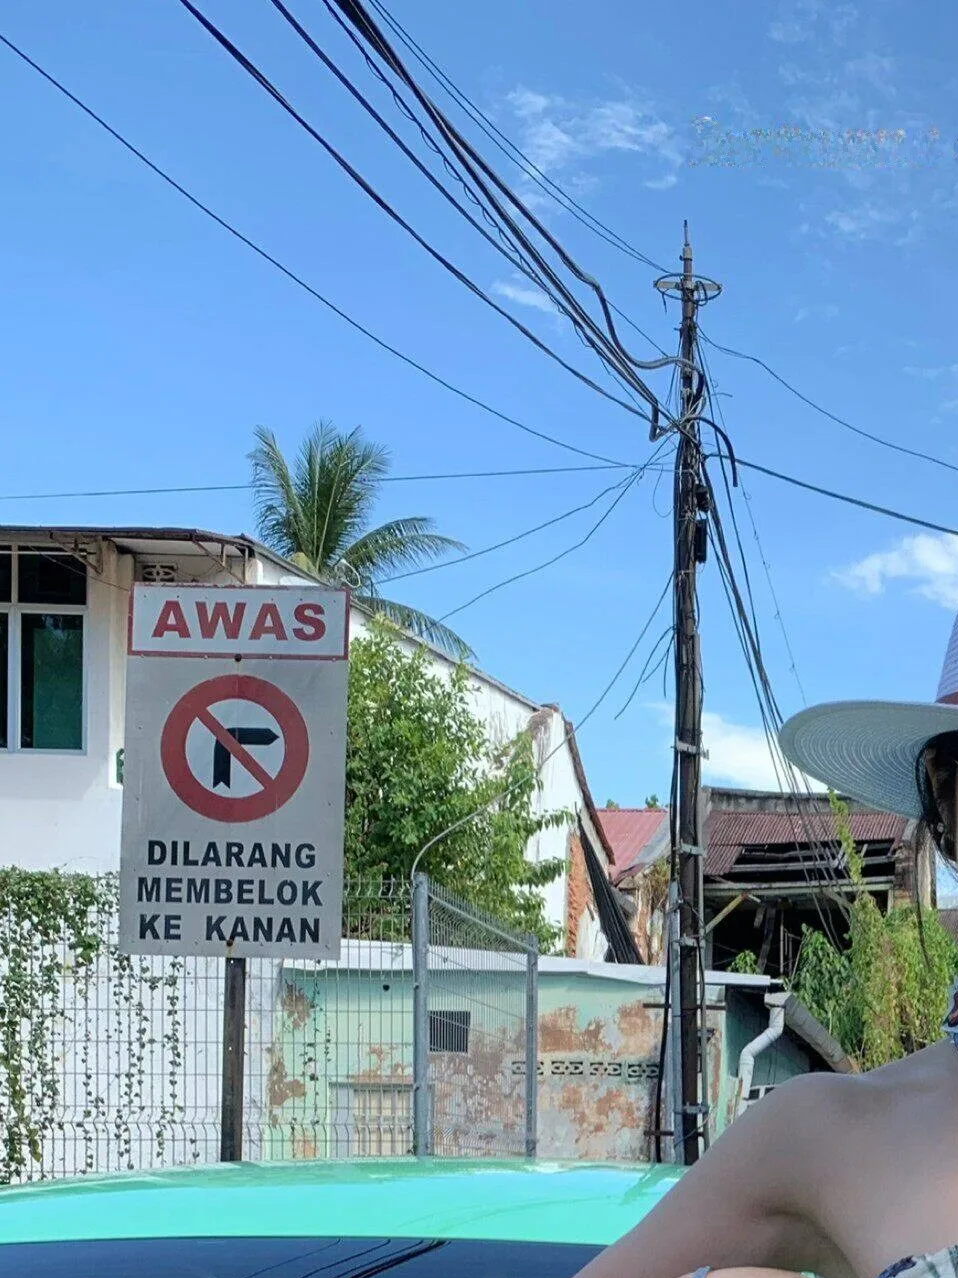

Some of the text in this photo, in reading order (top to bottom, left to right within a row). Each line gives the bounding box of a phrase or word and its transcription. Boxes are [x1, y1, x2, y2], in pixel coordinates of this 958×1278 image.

[151, 600, 326, 641] AWAS
[147, 839, 316, 869] DILARANG
[137, 876, 323, 906] MEMBELOK
[139, 914, 320, 943] KE KANAN
